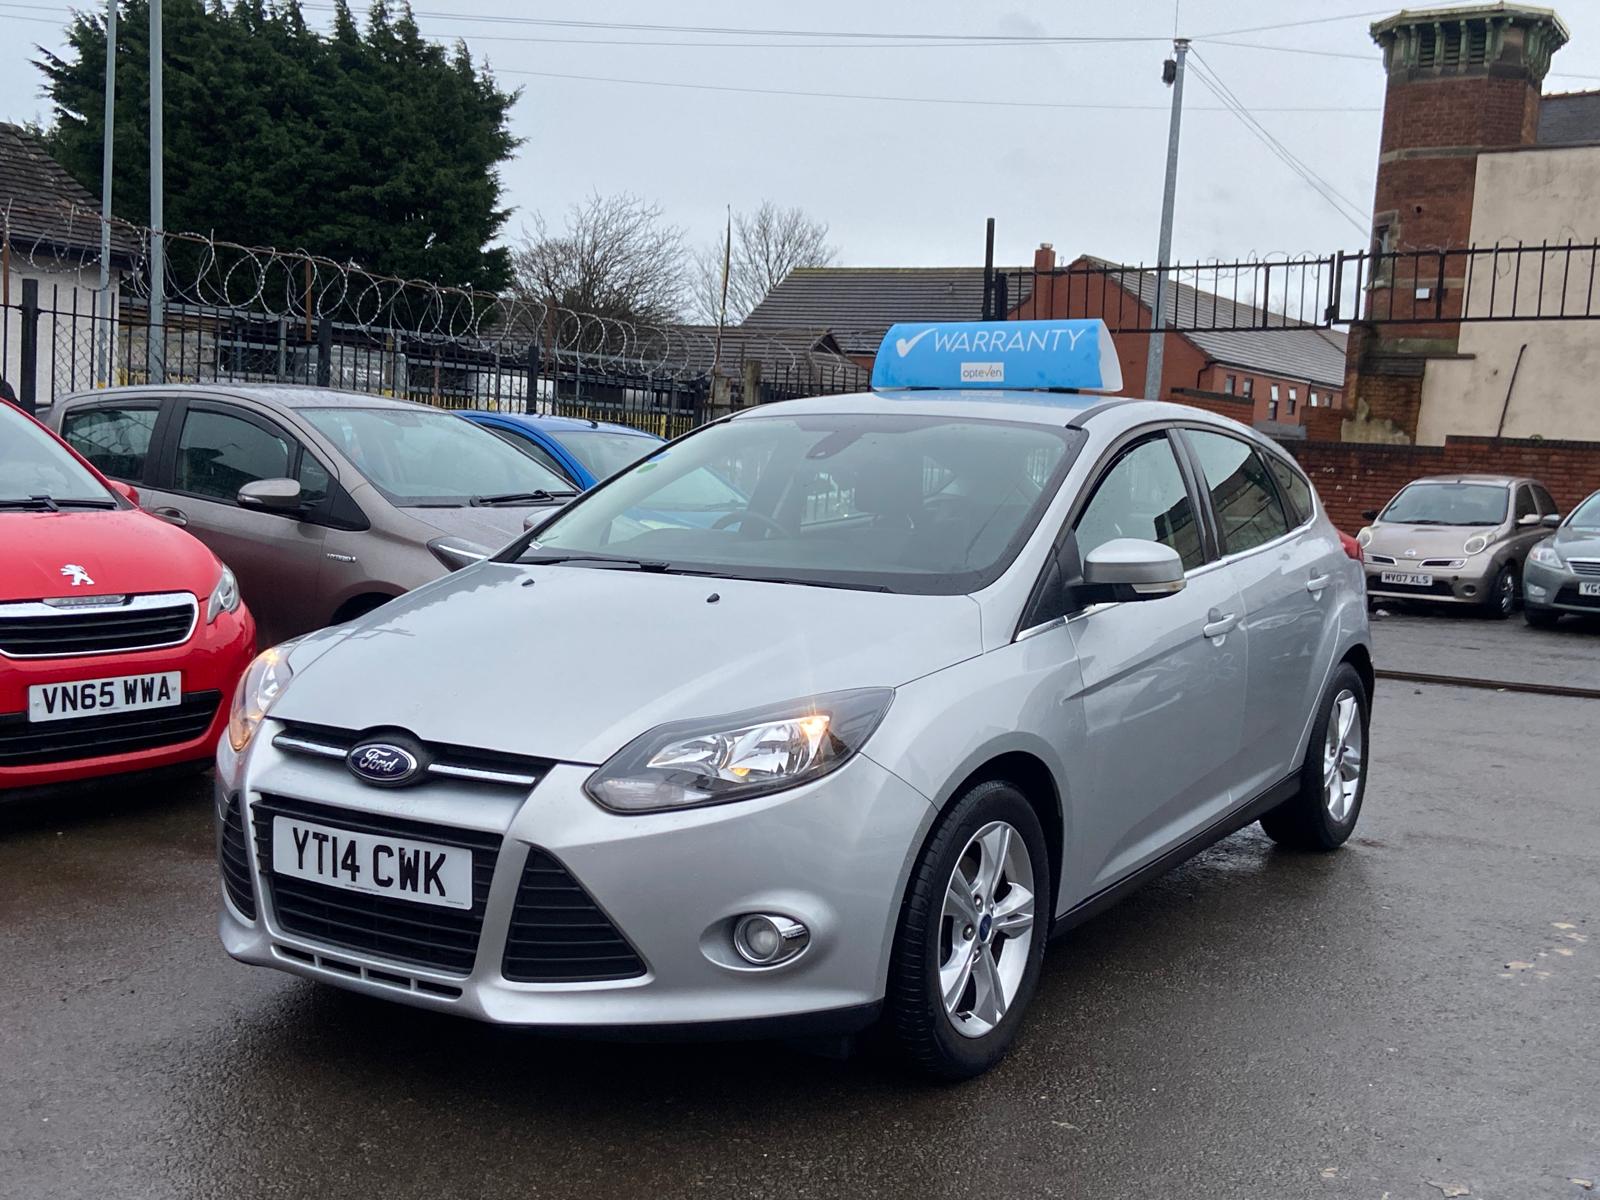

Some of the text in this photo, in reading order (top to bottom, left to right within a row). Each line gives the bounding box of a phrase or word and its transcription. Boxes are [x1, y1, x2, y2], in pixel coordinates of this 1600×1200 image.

[934, 328, 1086, 353] WARRANTY
[962, 365, 1003, 381] opteven
[1410, 575, 1429, 585] XLS
[42, 675, 171, 714] VN65 WWA
[359, 748, 399, 772] Ford
[292, 827, 446, 897] YT14 CWK
